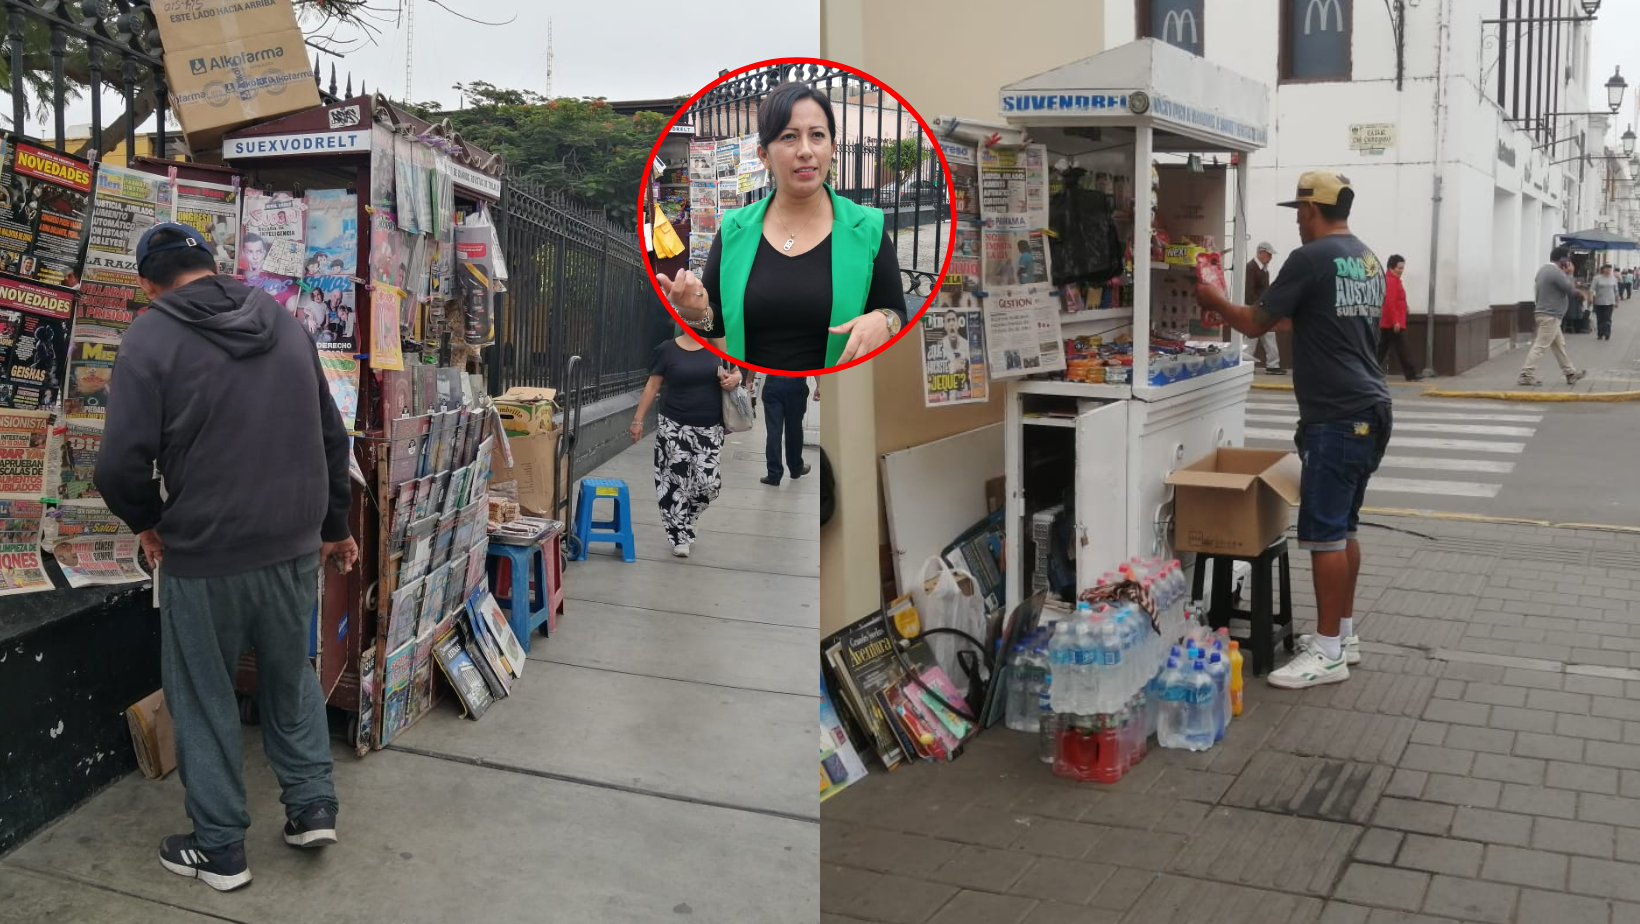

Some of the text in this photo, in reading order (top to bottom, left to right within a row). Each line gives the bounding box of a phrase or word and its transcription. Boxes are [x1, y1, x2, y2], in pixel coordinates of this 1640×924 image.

[170, 0, 276, 23] ESTE LADO HACIA ARRIBA
[210, 46, 284, 71] Alkofarma
[235, 134, 358, 154] SUEXVODRELT
[18, 151, 90, 185] NOVEDADES
[0, 286, 70, 313] NOVEDADES
[10, 364, 46, 382] GEISHAS
